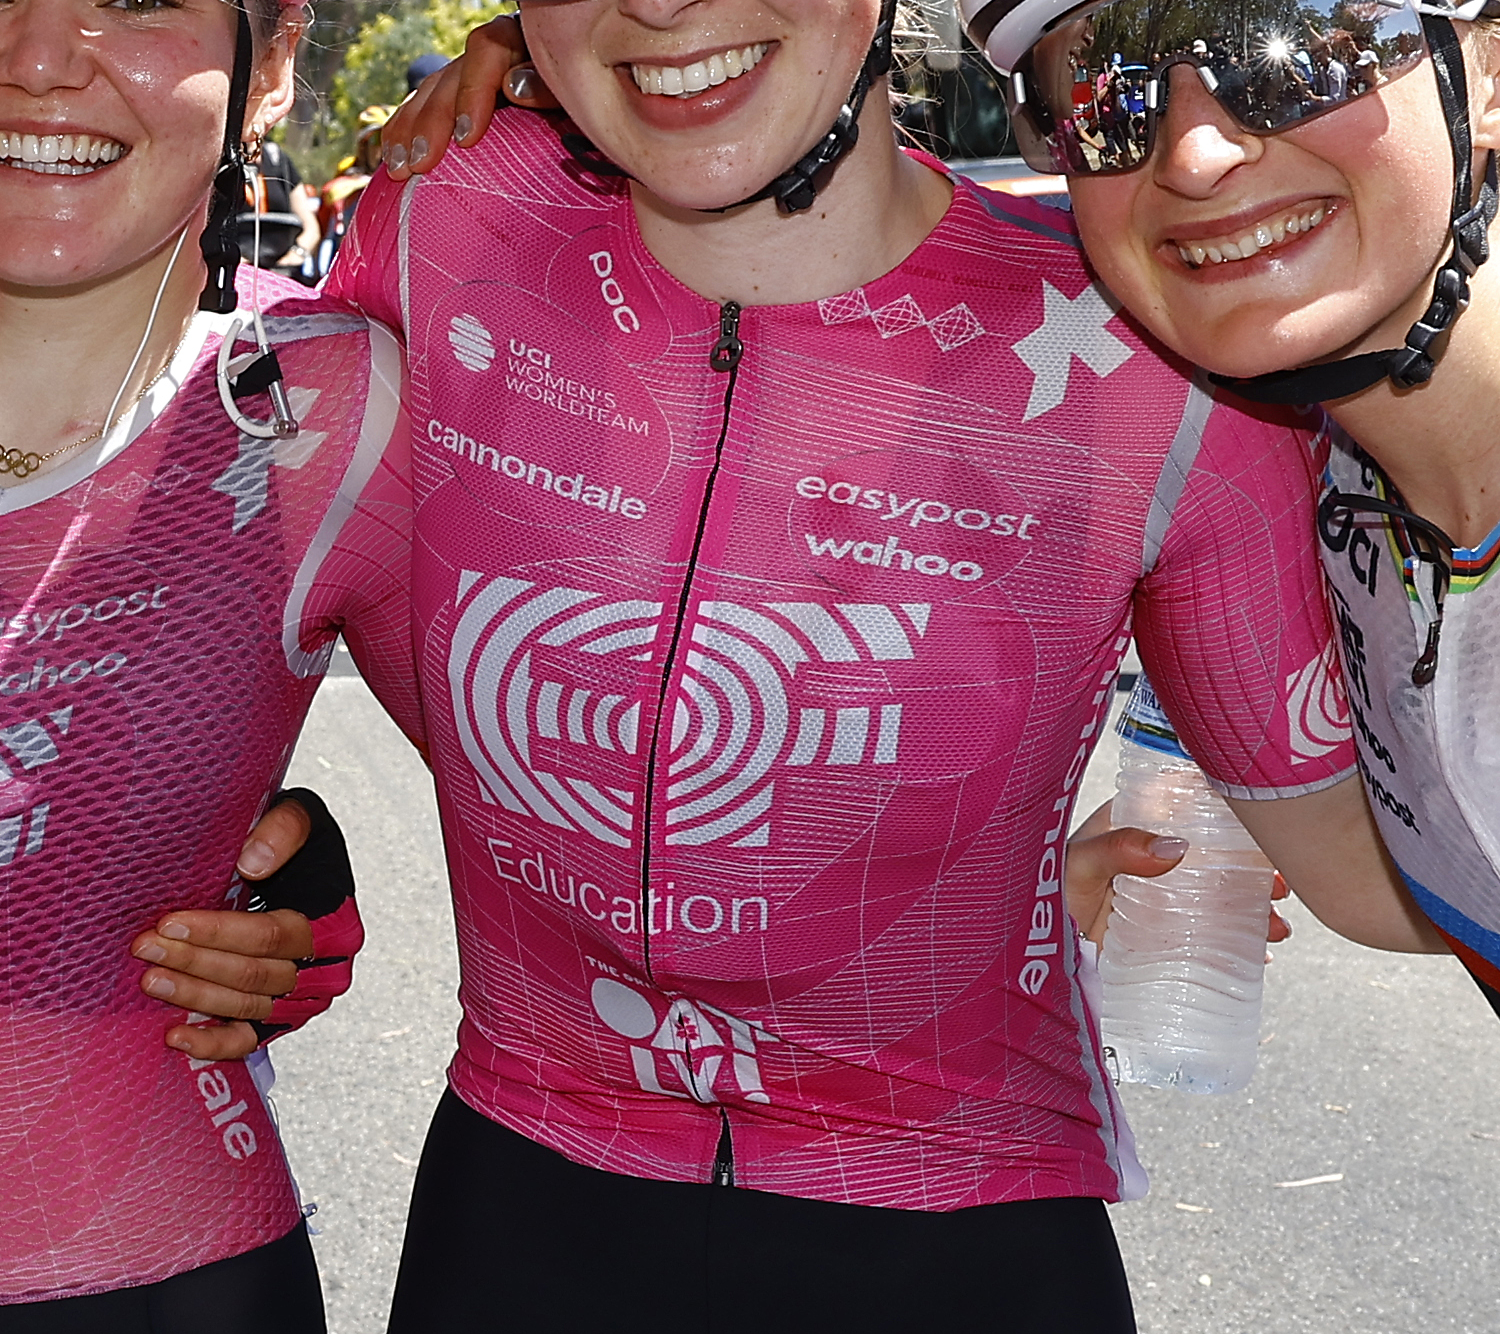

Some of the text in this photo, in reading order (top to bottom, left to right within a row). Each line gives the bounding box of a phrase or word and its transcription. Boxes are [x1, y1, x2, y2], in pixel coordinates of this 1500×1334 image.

[588, 249, 640, 335] poc
[506, 355, 618, 411] WOMEN'S
[507, 337, 552, 369] UCI
[505, 372, 651, 439] WORLDTEAM
[426, 418, 649, 522] cannondale
[795, 473, 1042, 543] easypost
[804, 532, 985, 584] wahoo
[486, 837, 770, 938] Education
